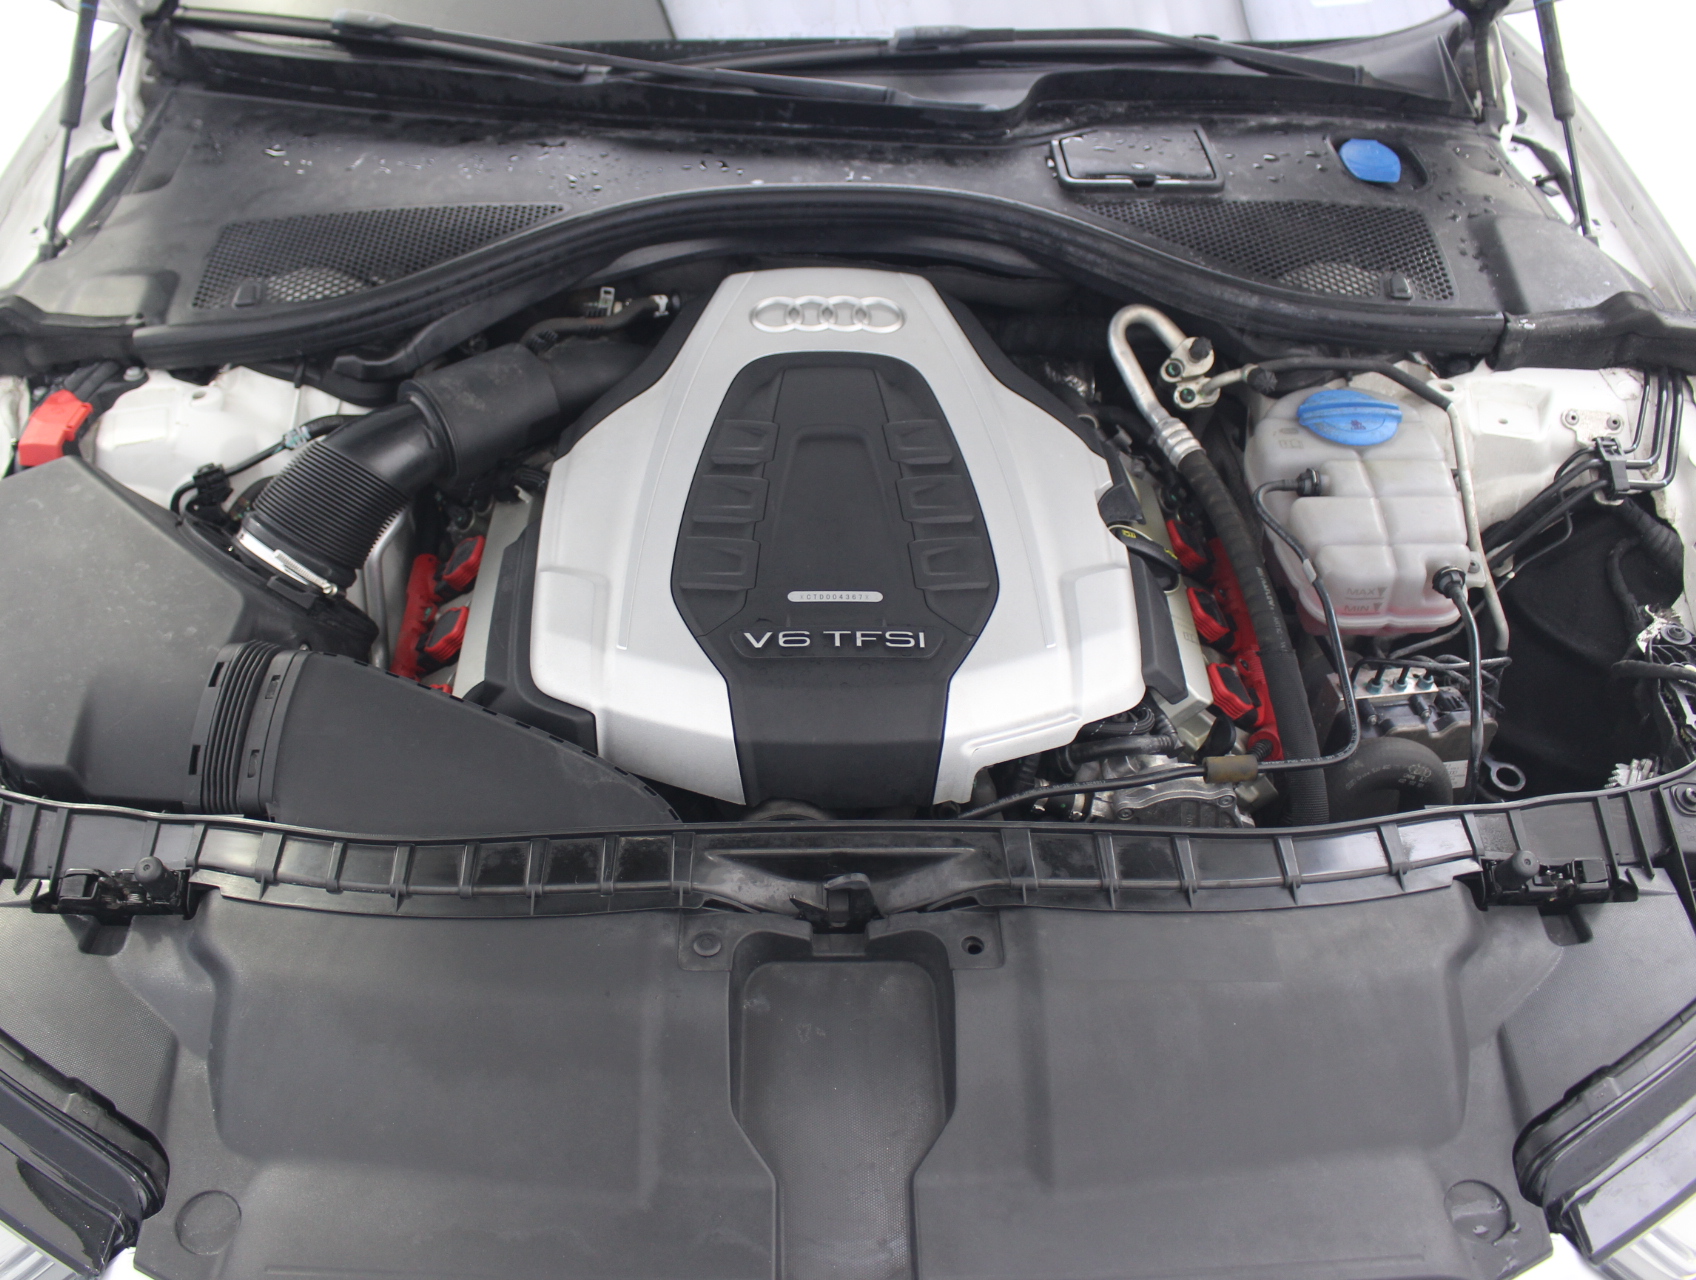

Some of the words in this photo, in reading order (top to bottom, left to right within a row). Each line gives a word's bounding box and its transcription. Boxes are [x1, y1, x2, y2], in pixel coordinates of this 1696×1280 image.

[1346, 587, 1376, 596] MAX
[1343, 604, 1370, 612] MIN
[743, 630, 811, 648] V6
[823, 630, 926, 648] TFSI
